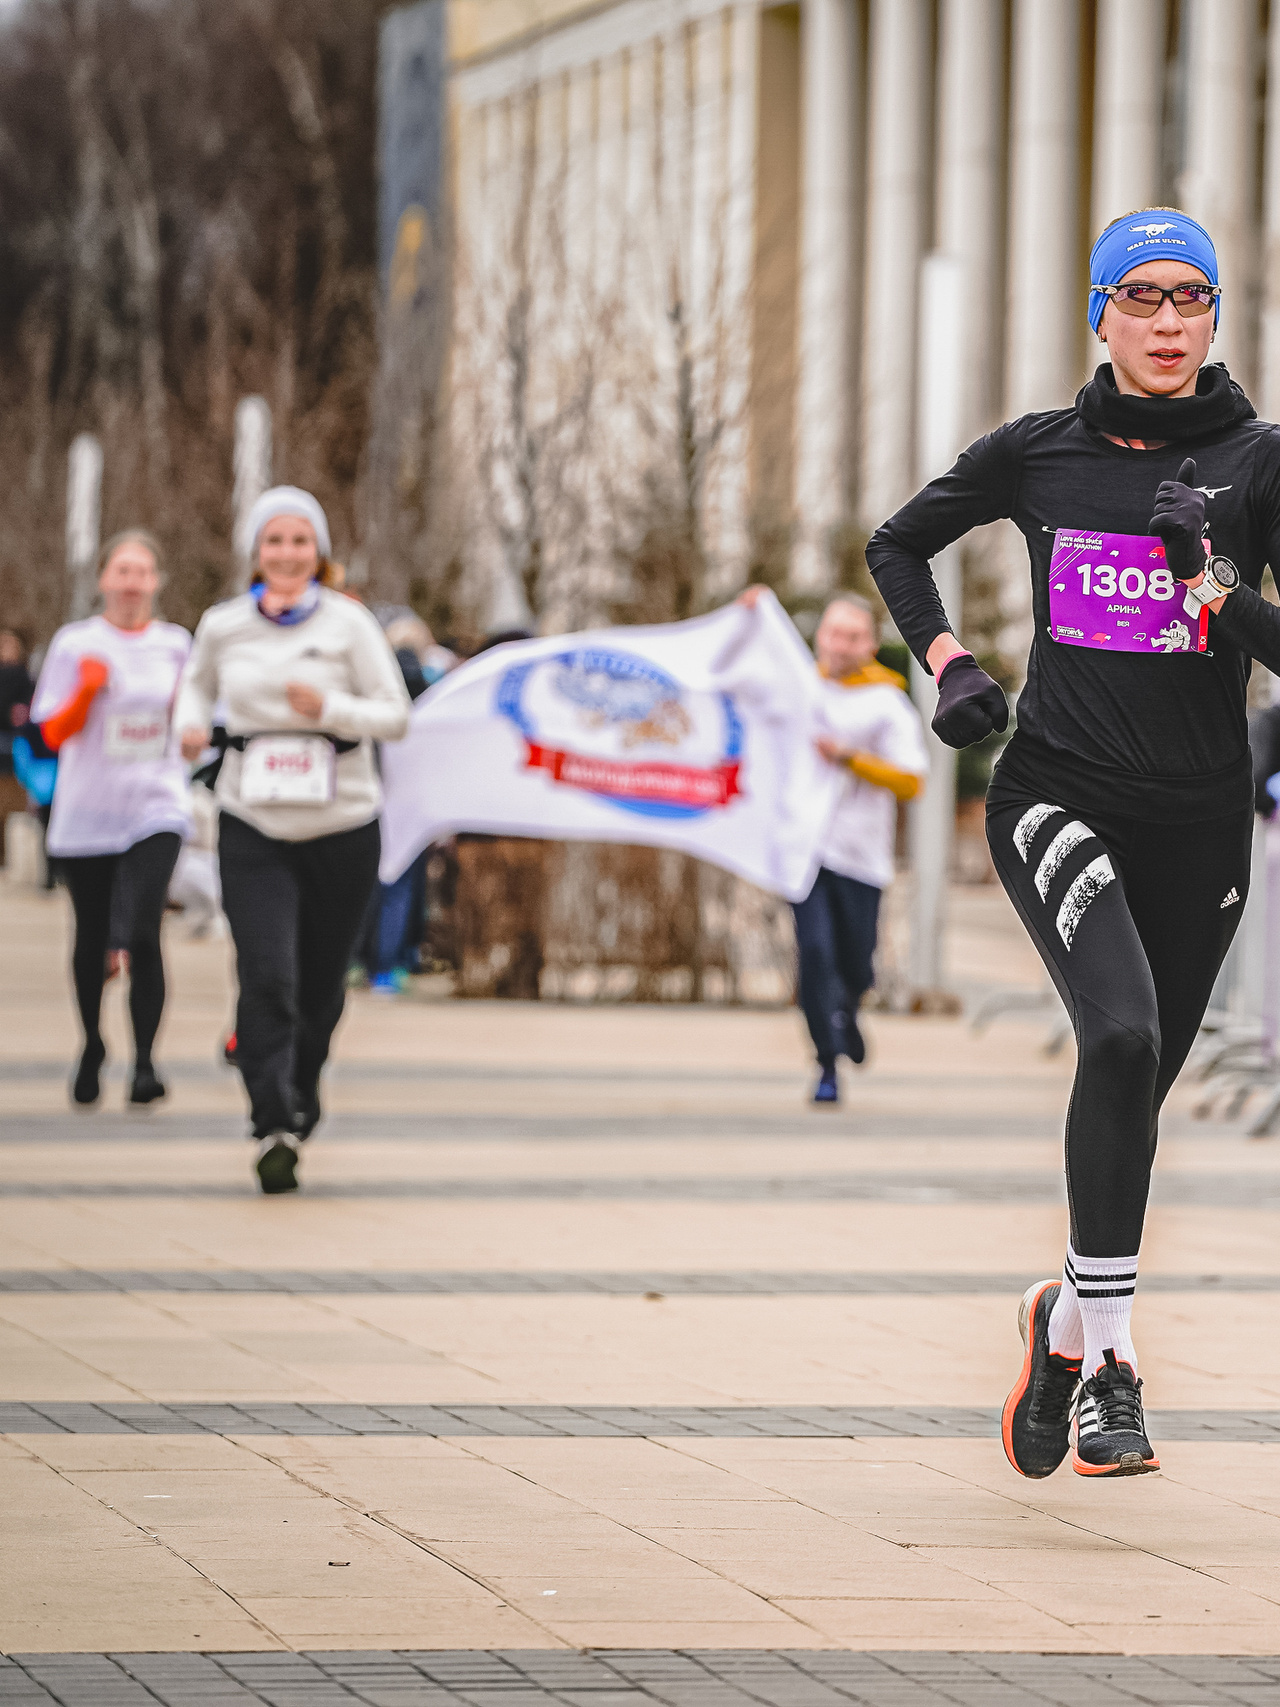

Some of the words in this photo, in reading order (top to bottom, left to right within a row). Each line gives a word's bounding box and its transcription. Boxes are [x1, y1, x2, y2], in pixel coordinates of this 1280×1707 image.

[1126, 240, 1144, 252] MAD
[1145, 238, 1160, 246] FOX
[1161, 238, 1187, 246] ULTRA
[1073, 543, 1103, 551] MARATHON
[1077, 563, 1176, 602] 1308
[1106, 603, 1141, 615] АРИНА
